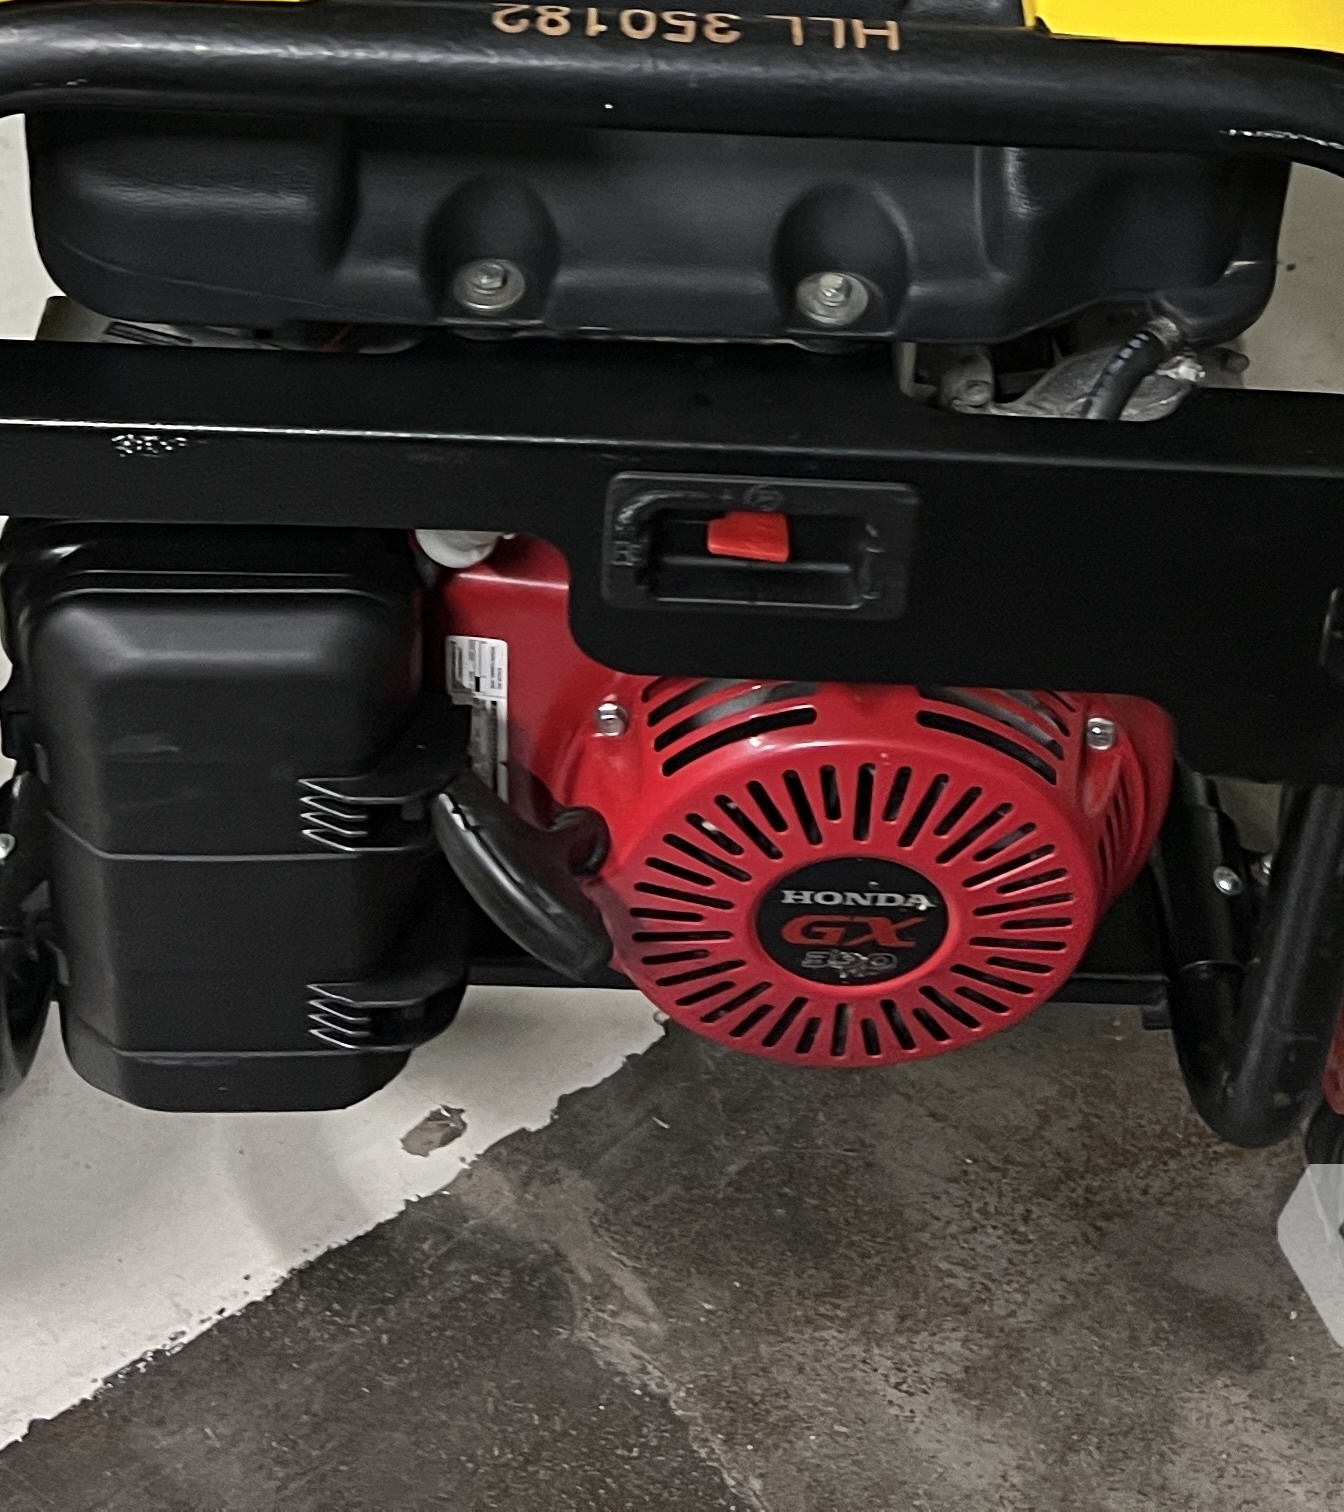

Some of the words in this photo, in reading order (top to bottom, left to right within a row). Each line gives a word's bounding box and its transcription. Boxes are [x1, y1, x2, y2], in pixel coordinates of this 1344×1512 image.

[490, 3, 742, 44] 350182
[763, 14, 901, 51] HLL
[780, 889, 937, 909] HONDA
[780, 914, 927, 948] GX
